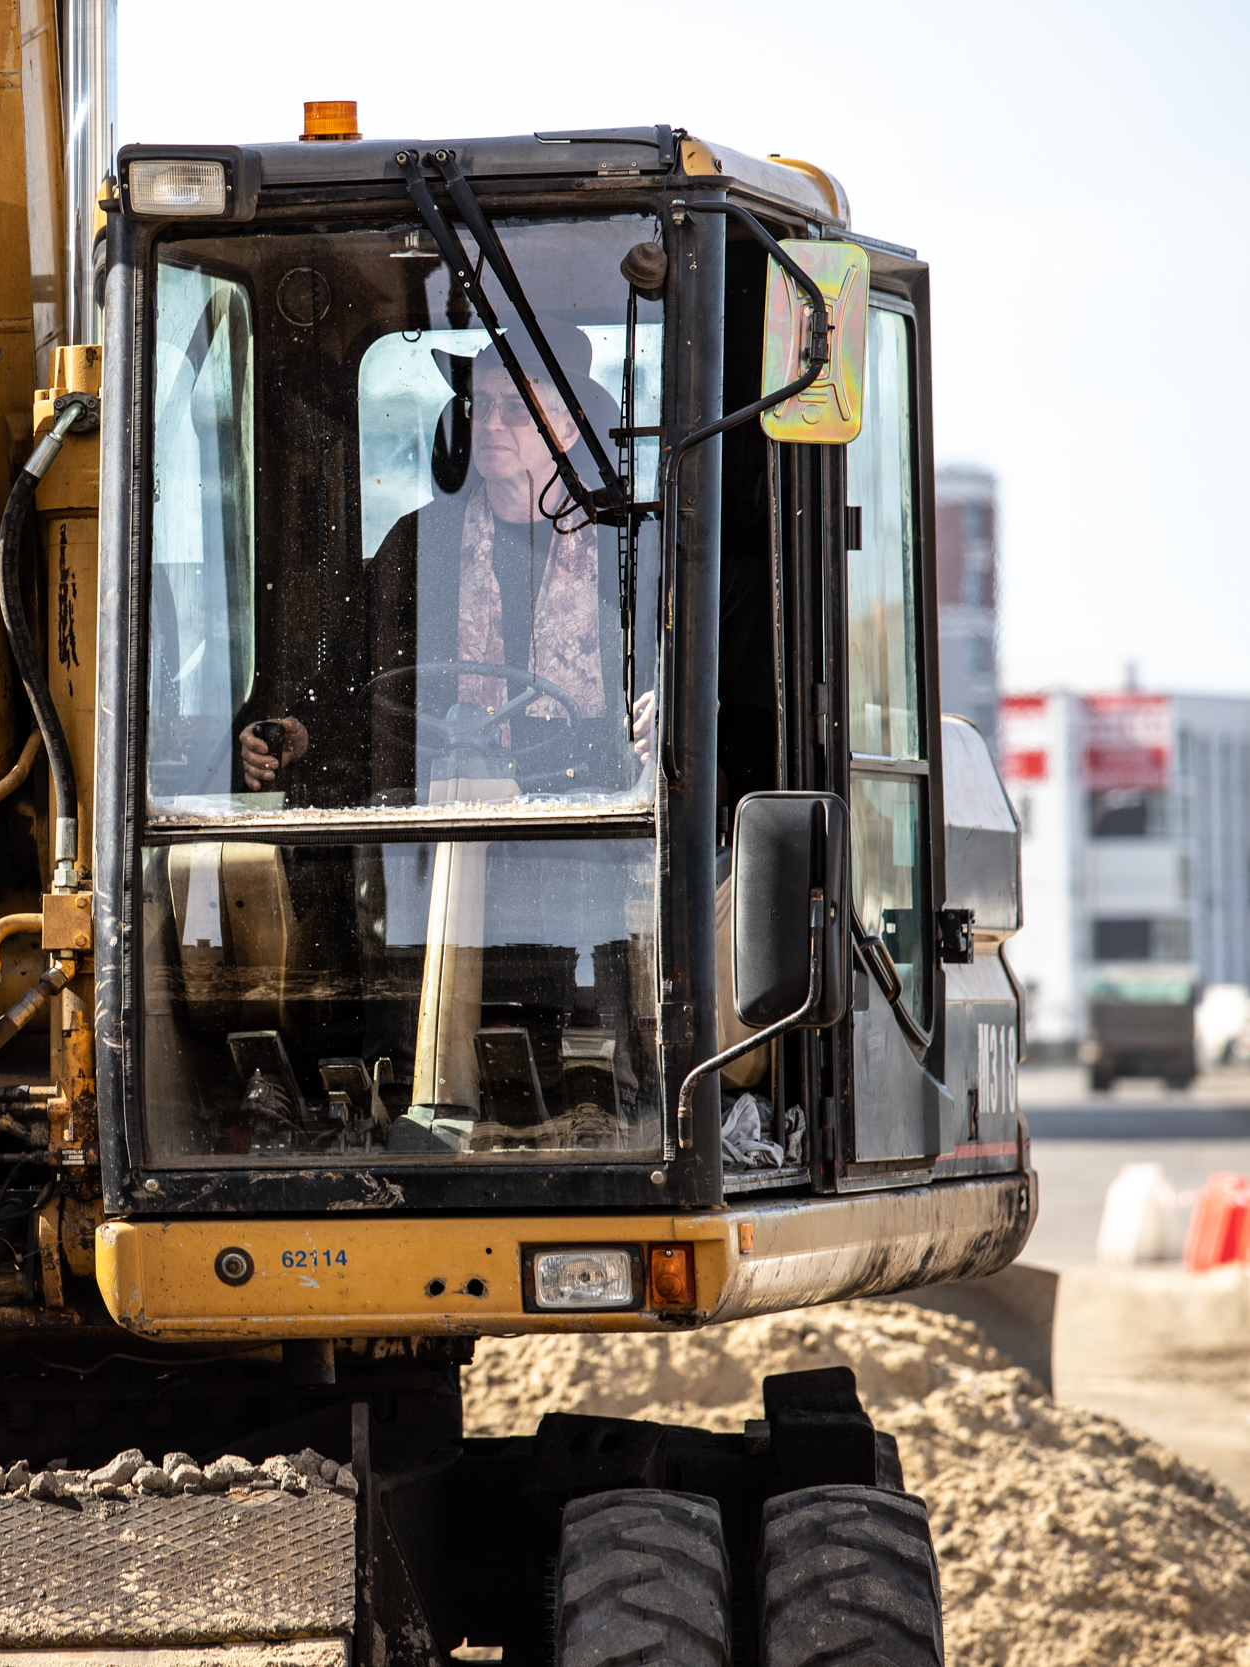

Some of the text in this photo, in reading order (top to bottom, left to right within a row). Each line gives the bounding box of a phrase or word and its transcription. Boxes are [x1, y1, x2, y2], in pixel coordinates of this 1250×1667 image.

[5, 530, 13, 550] MSHA
[978, 1023, 1016, 1115] M318
[281, 1249, 348, 1269] 62114
